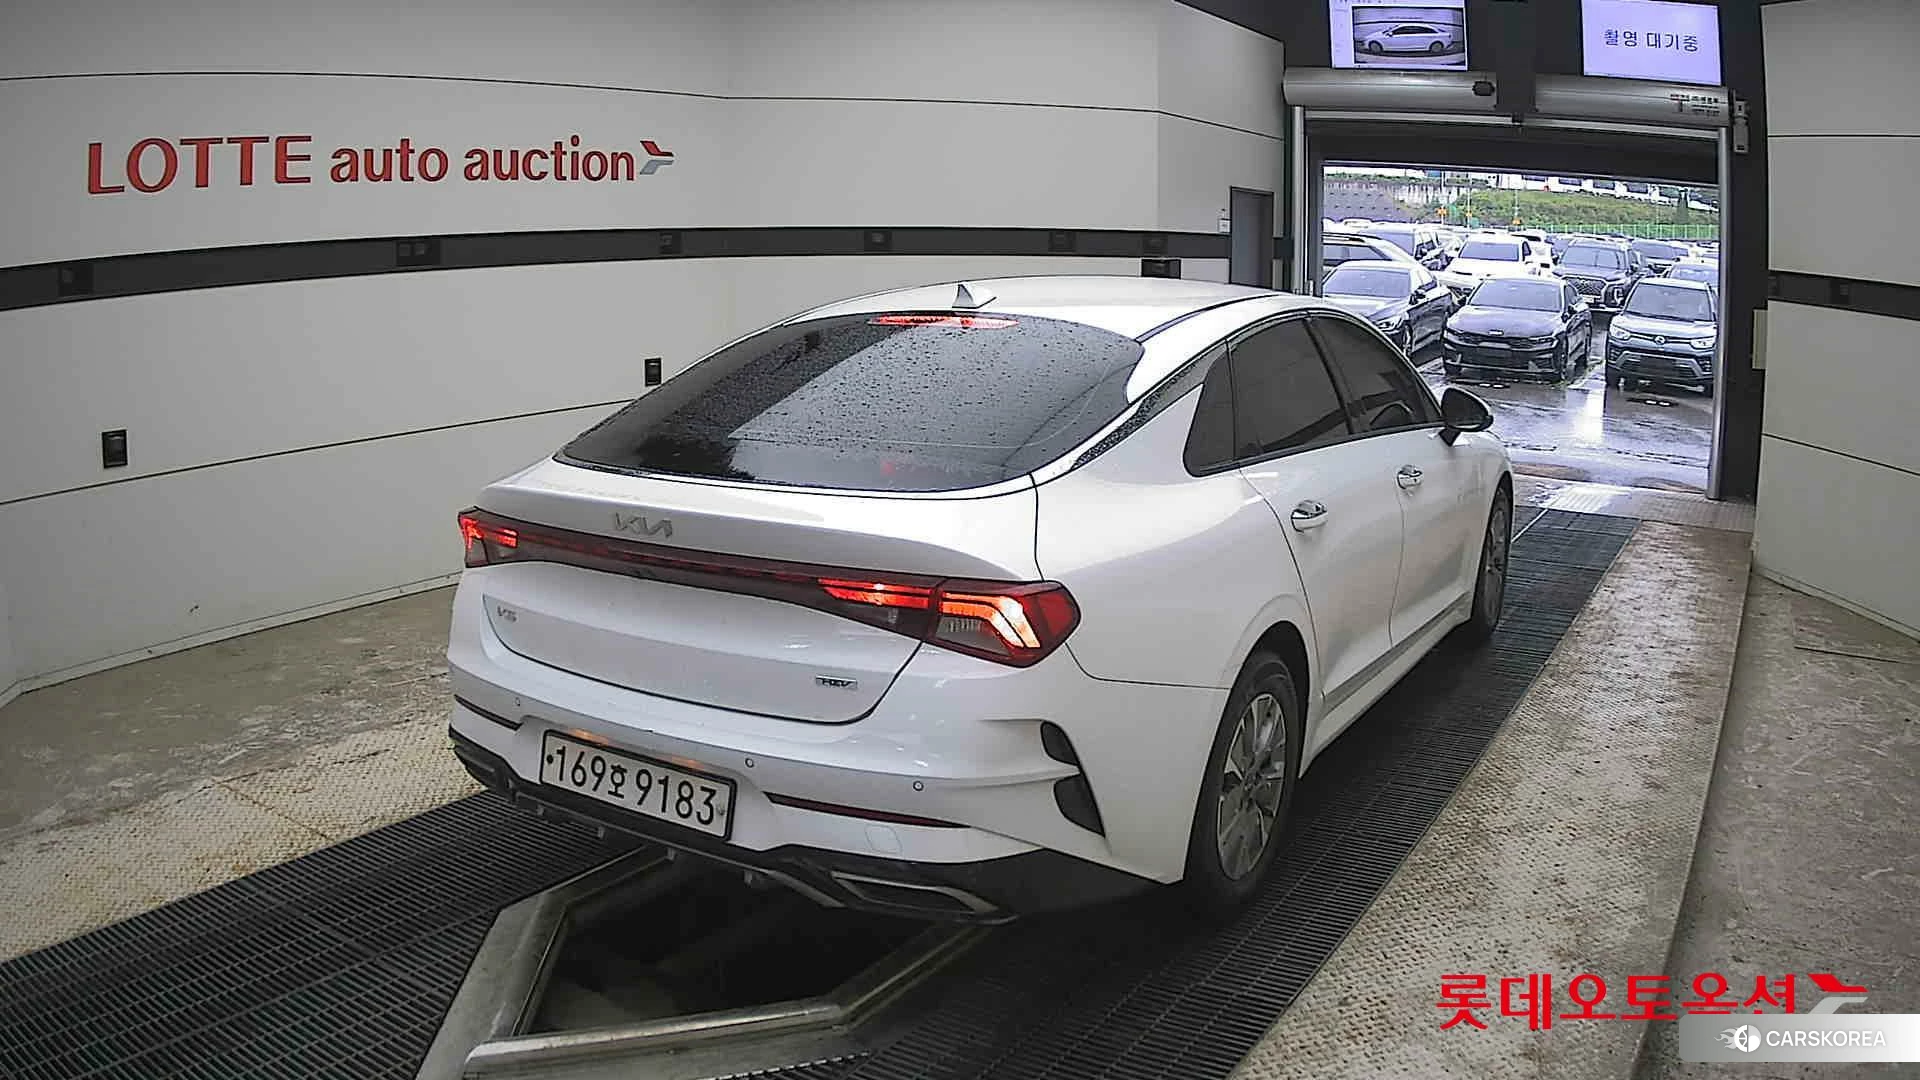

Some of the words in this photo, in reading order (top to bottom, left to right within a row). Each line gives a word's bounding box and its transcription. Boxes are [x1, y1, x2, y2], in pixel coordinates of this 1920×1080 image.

[1646, 32, 1698, 52] 대기중
[87, 135, 312, 194] LOTTE
[329, 137, 449, 183] auto
[463, 135, 635, 182] auction
[615, 512, 673, 538] KIA
